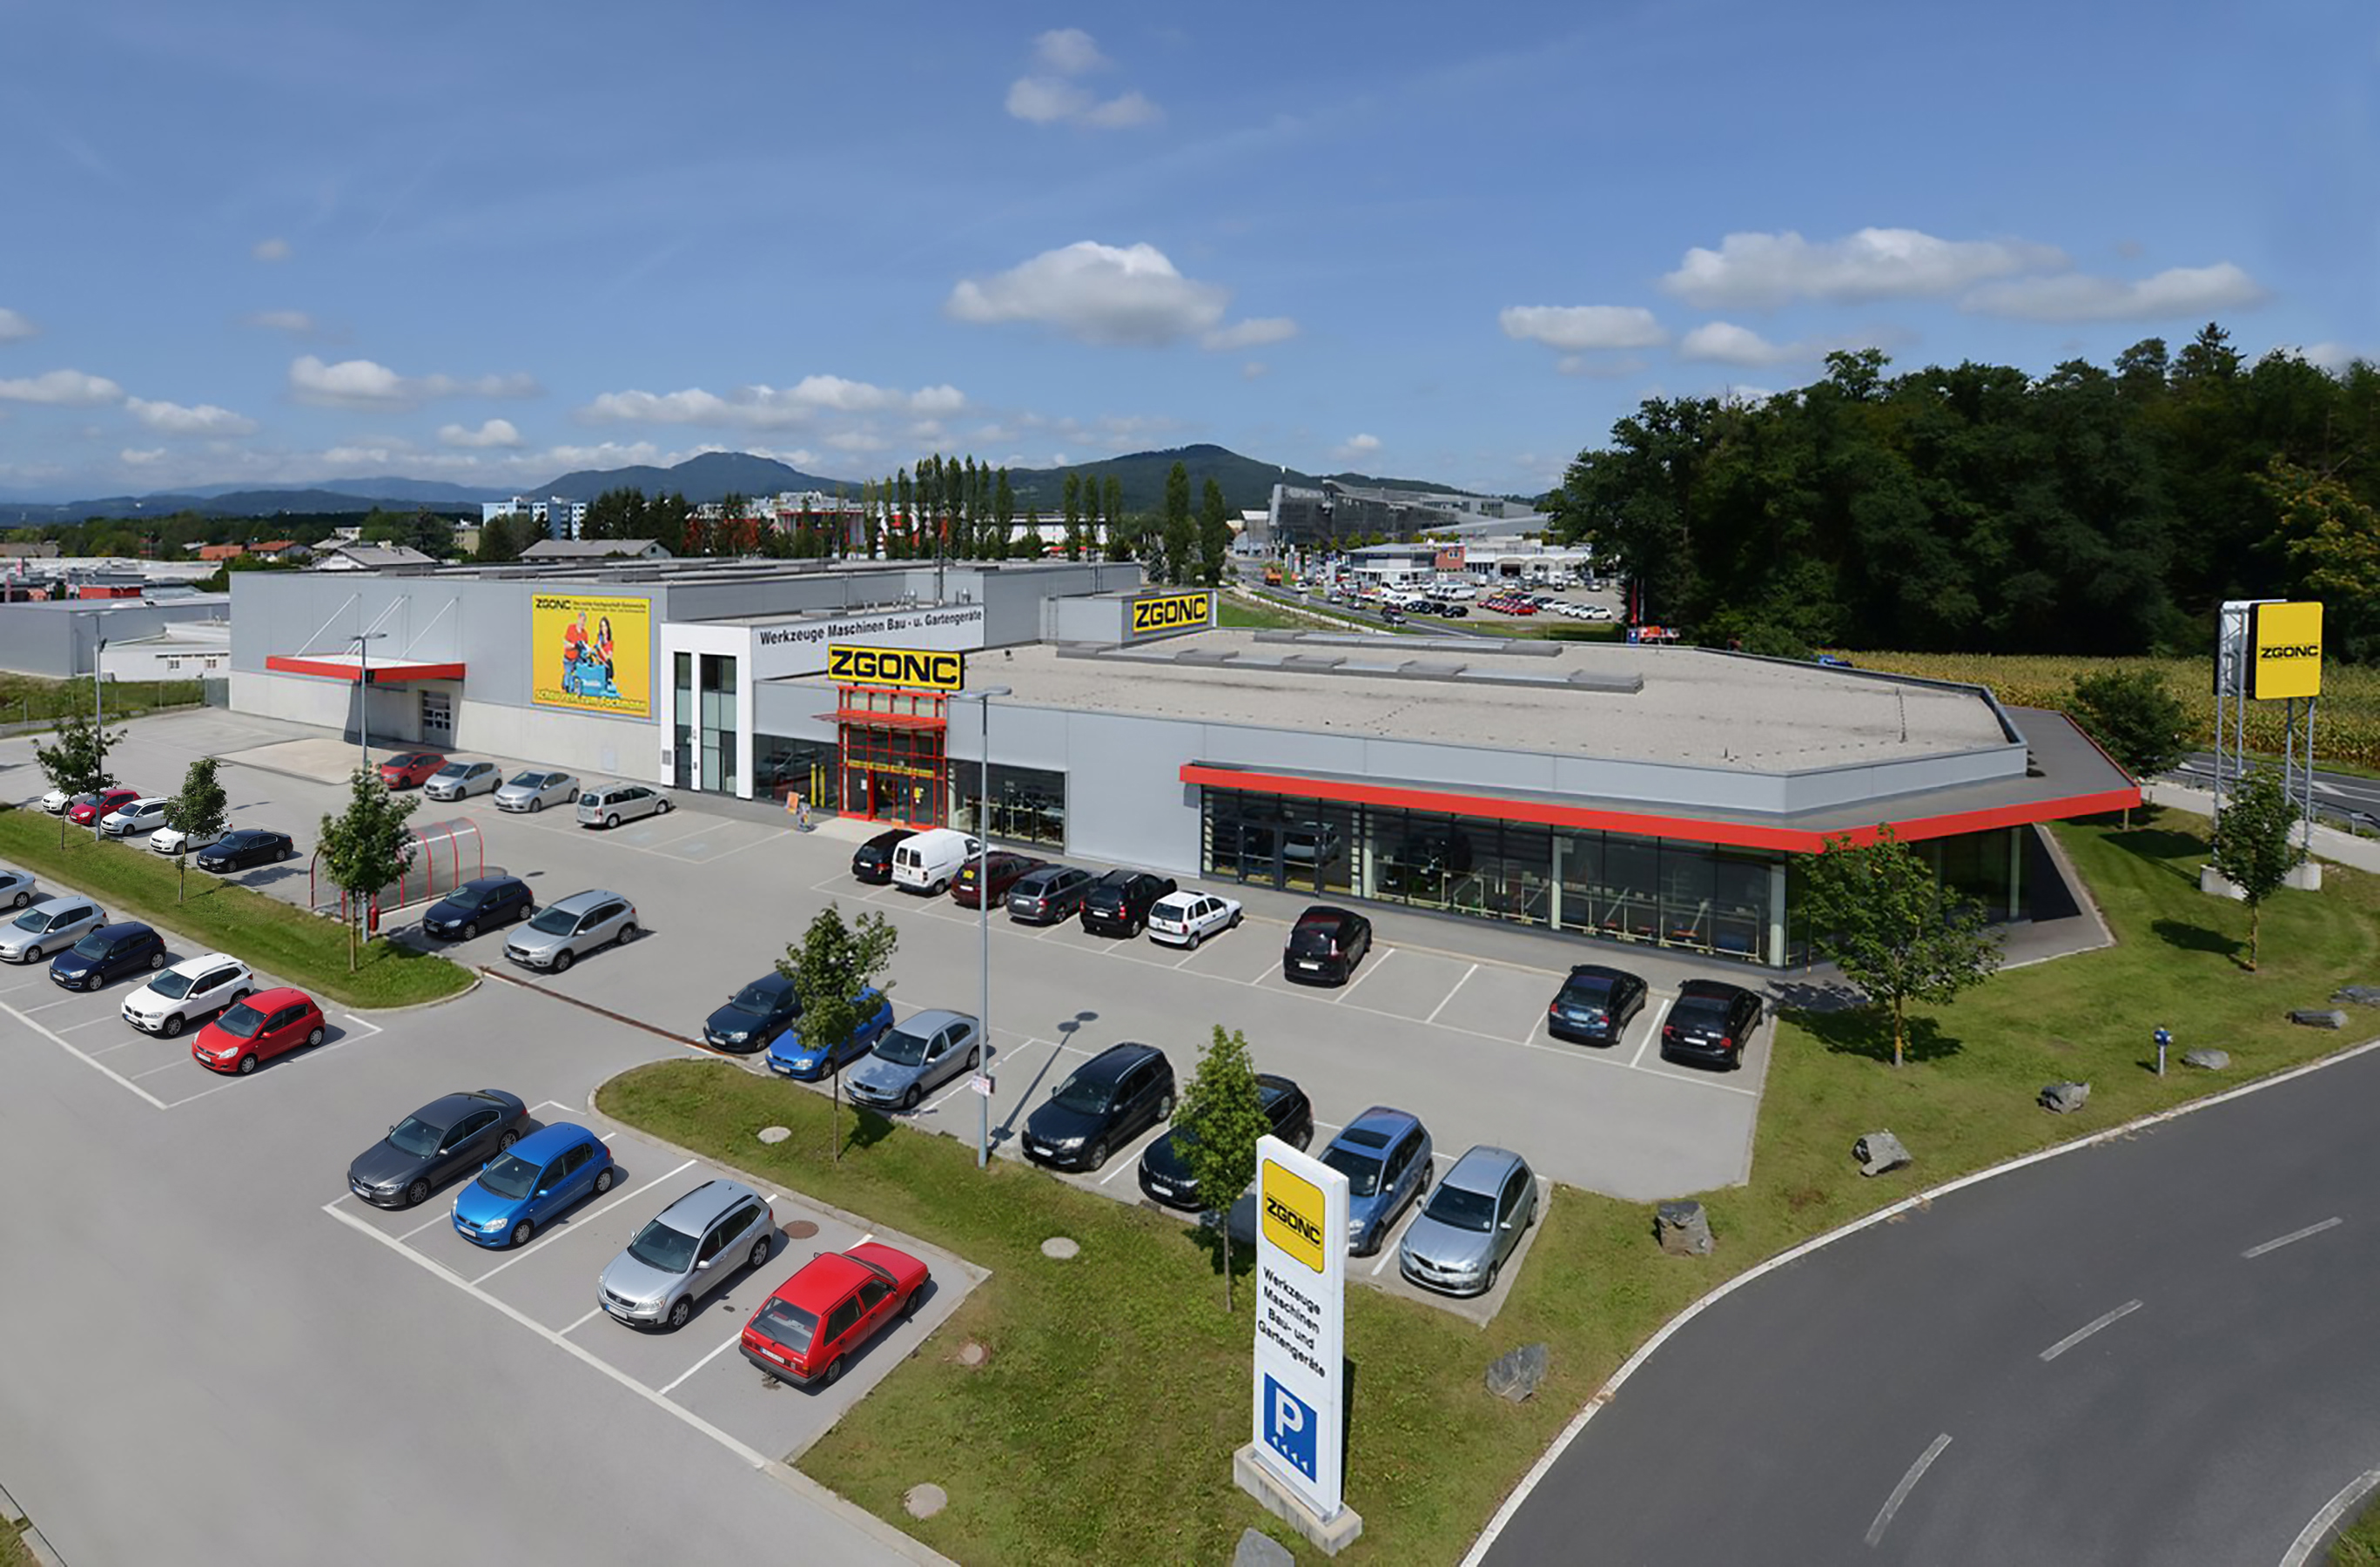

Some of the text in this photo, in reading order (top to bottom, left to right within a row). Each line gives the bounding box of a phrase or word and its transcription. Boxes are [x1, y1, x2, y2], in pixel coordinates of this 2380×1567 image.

[535, 598, 571, 609] ZGONC
[1136, 597, 1206, 628] ZGONC
[760, 624, 824, 645] Werkzeuge
[828, 621, 884, 637] Maschinen
[925, 610, 981, 626] Gartengeräte
[831, 650, 958, 683] ZGONC
[2261, 646, 2318, 658] ZGONC
[1267, 1197, 1321, 1245] ZGONC
[1263, 1267, 1321, 1315] Werkzeuge
[1264, 1286, 1320, 1334] Maschinen
[1258, 1320, 1326, 1378] Gartengeräte
[1268, 1308, 1314, 1350] Bau- und
[1275, 1387, 1304, 1438] P
